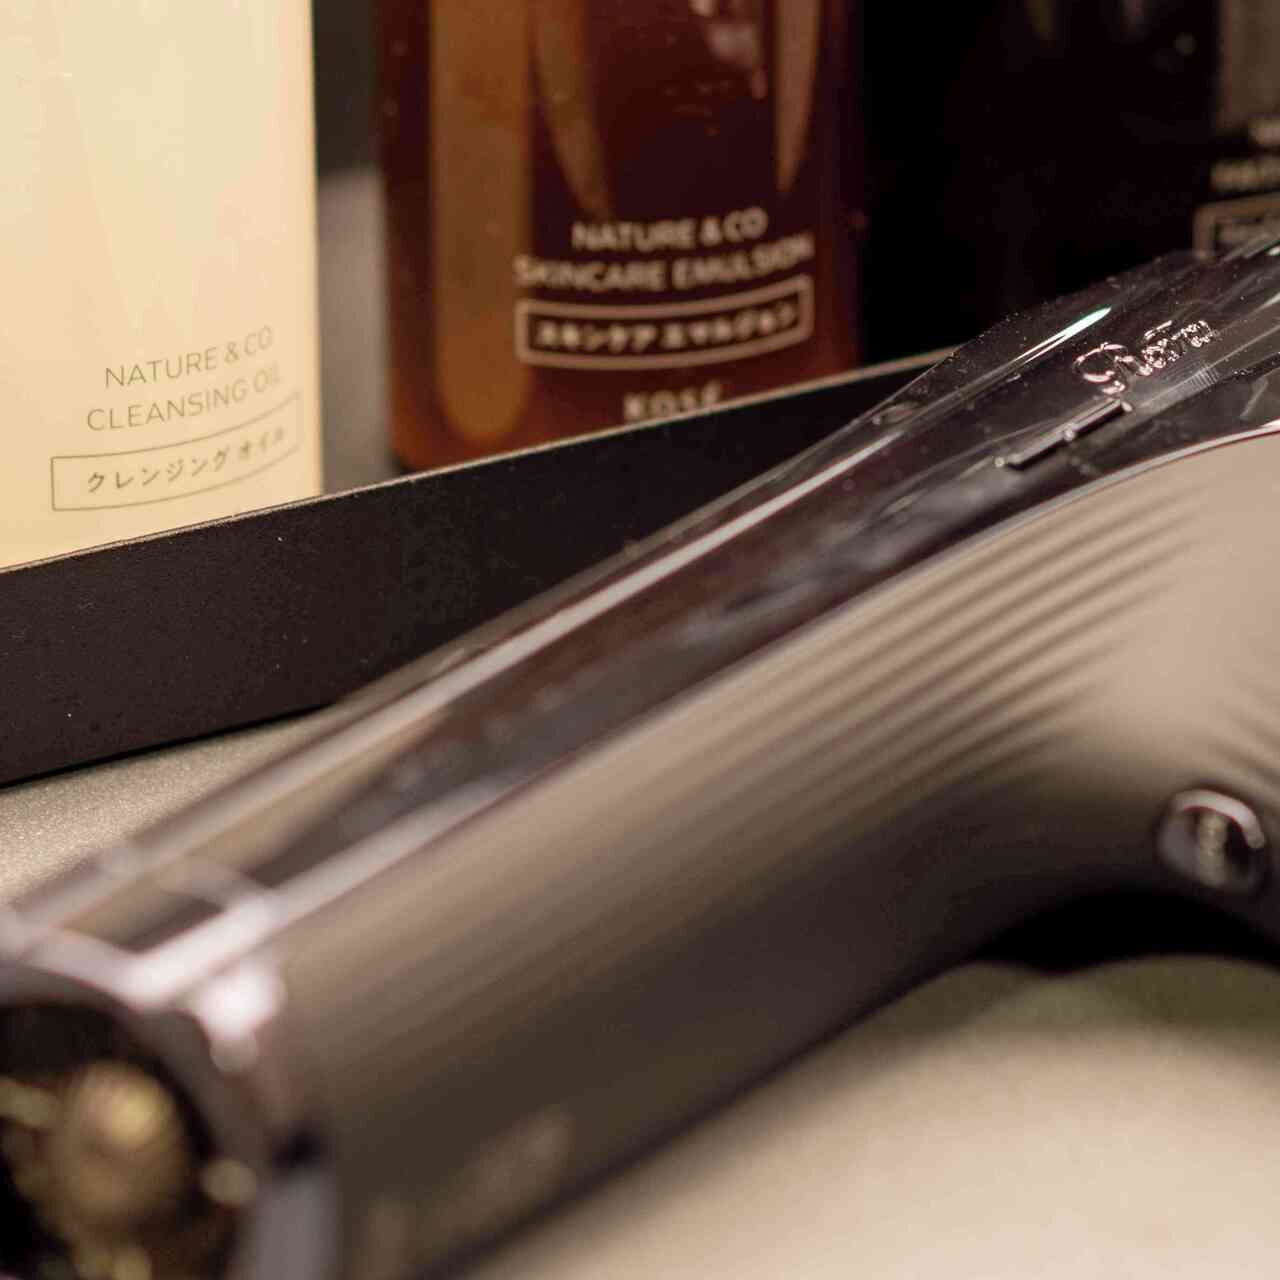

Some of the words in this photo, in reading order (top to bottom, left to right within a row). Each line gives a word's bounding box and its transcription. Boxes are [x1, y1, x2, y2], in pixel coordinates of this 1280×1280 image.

[571, 219, 696, 252] NATURE
[722, 205, 769, 242] CO
[513, 253, 666, 292] SKINCARE
[672, 232, 815, 290] EMULSION
[105, 346, 217, 389] NATURE
[223, 340, 241, 364] &
[244, 324, 273, 356] CO
[87, 378, 248, 432] CLEANSING
[253, 361, 281, 394] OIL
[88, 447, 230, 494] クレンジング
